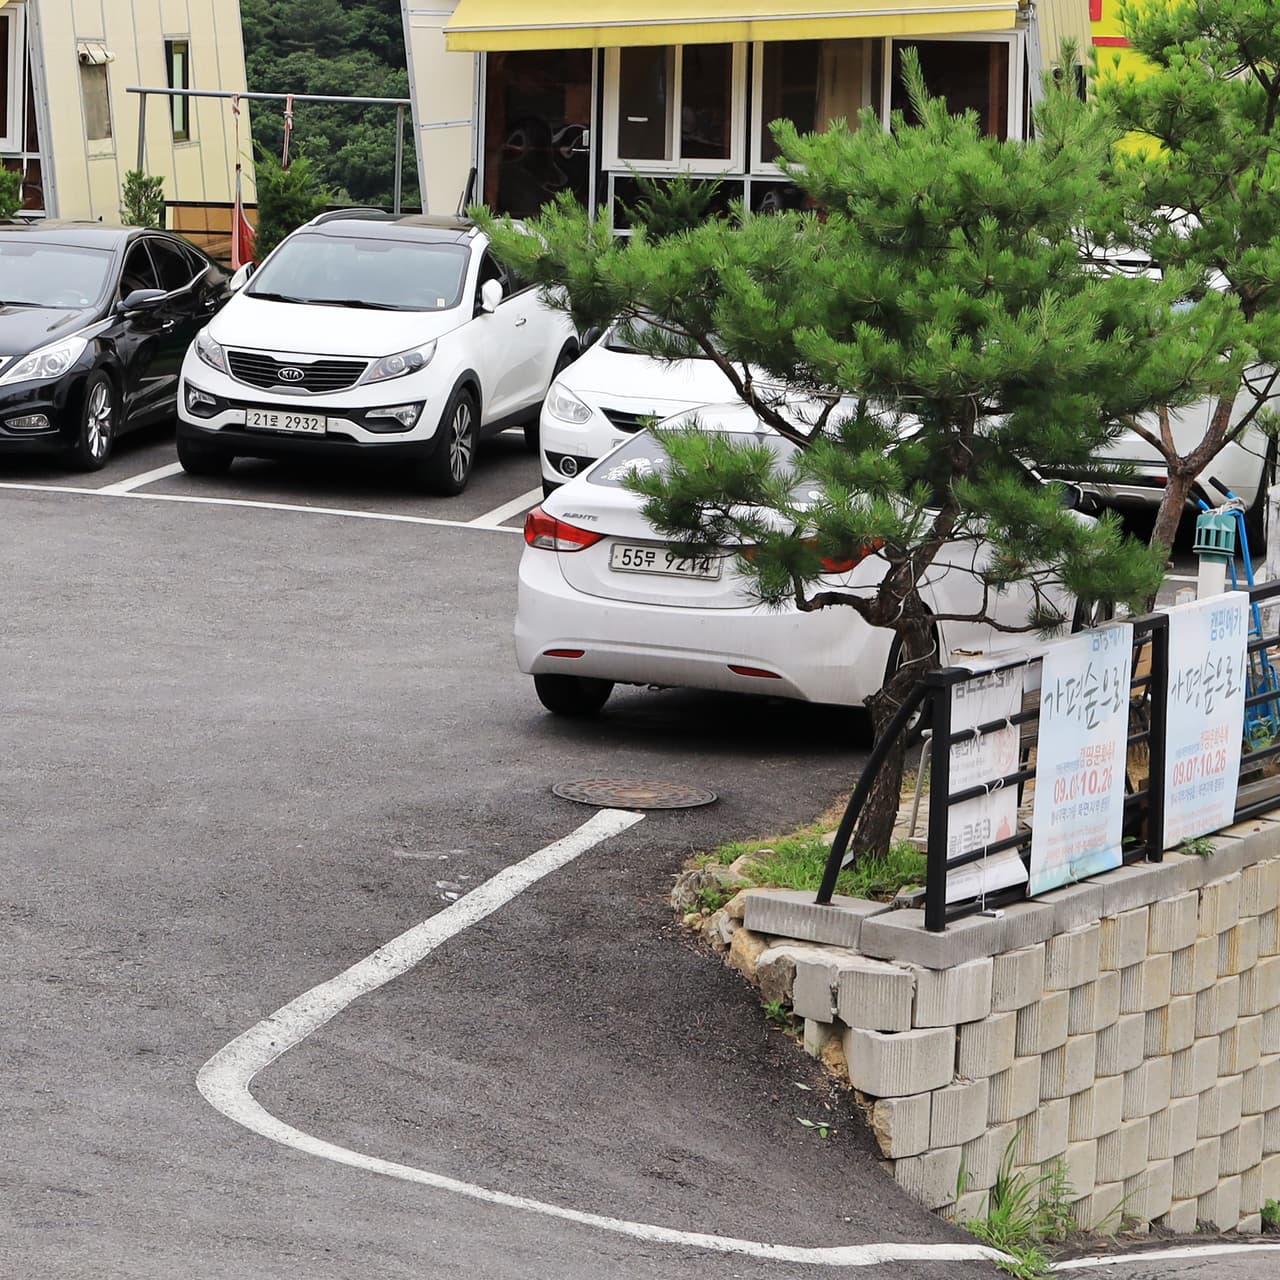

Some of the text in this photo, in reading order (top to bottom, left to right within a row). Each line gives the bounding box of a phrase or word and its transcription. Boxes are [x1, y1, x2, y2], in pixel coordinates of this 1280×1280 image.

[282, 370, 300, 379] KIA
[285, 415, 319, 430] 2932
[621, 548, 656, 568] 55무
